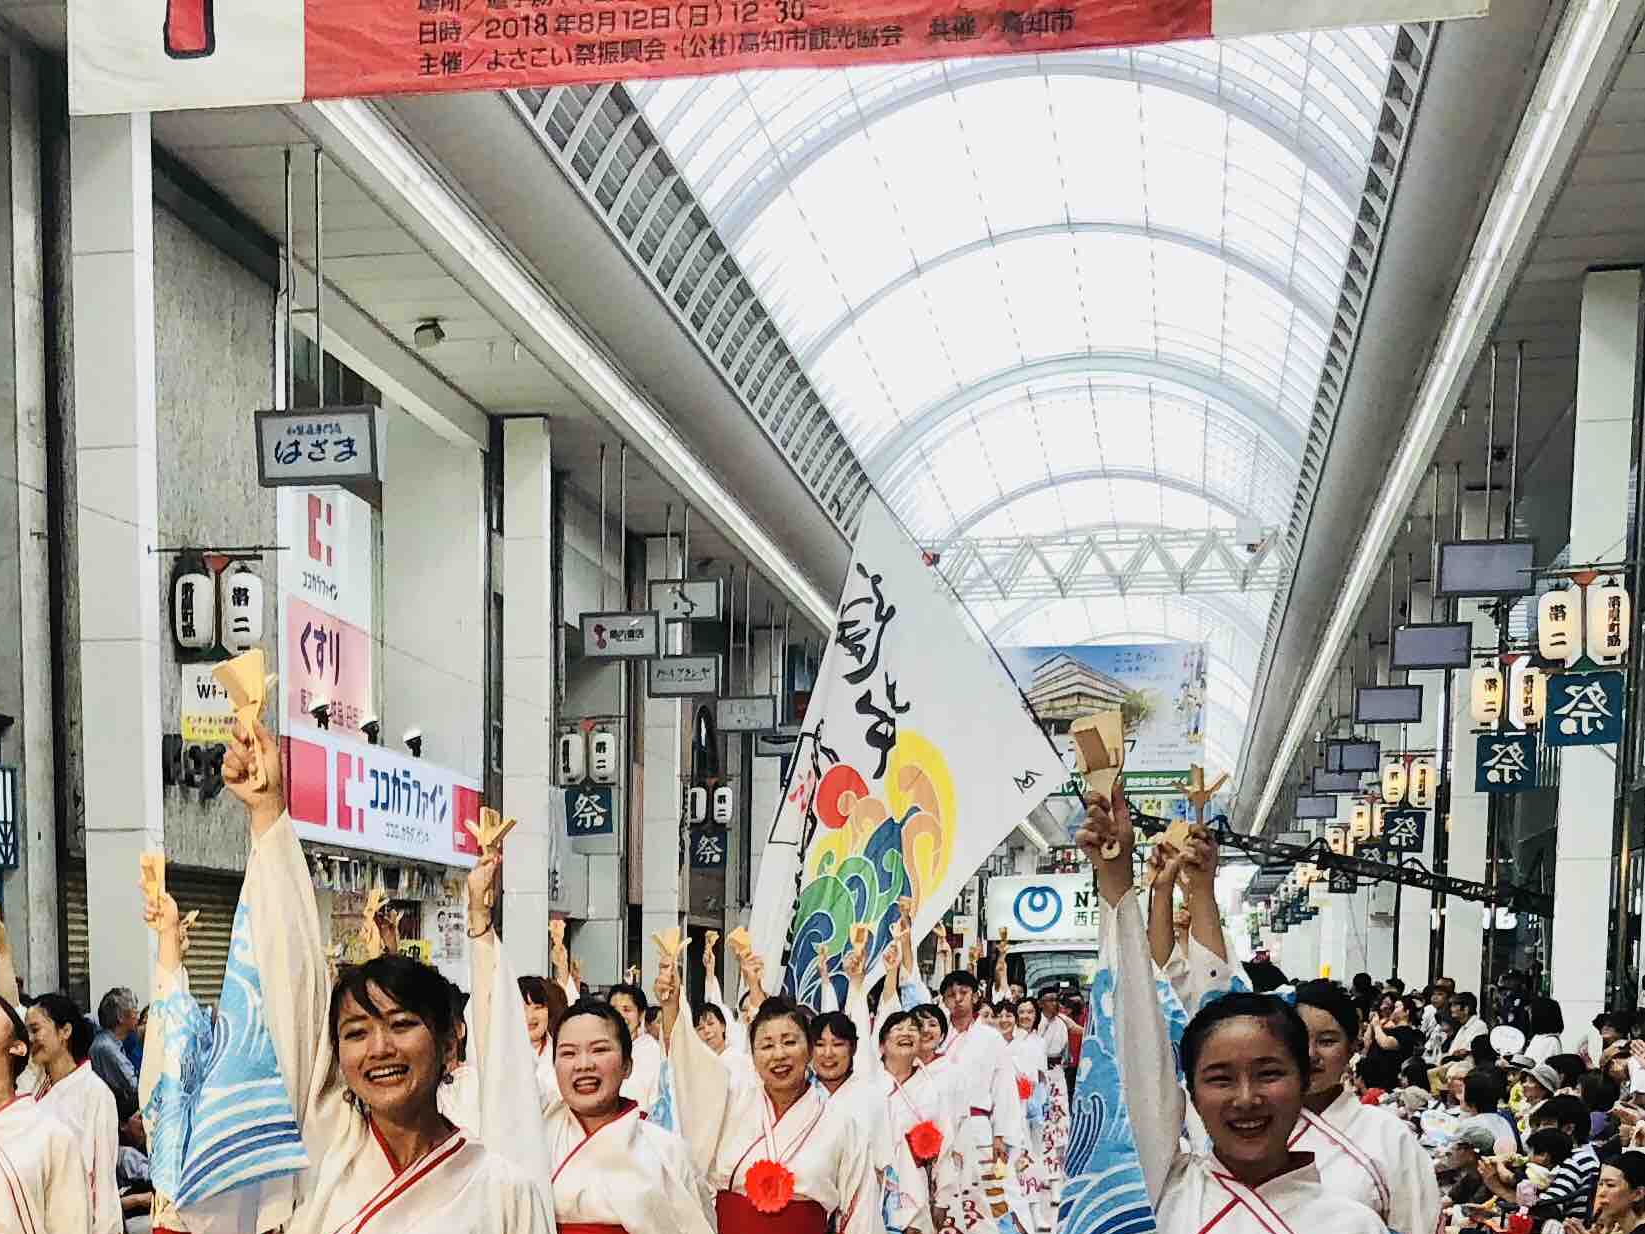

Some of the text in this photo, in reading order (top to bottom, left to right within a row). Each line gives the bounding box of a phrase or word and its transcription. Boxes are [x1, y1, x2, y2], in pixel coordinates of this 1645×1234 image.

[300, 621, 340, 687] くすり
[369, 767, 447, 825] ココカラファイン
[572, 793, 607, 829] 祭
[695, 834, 724, 864] 祭
